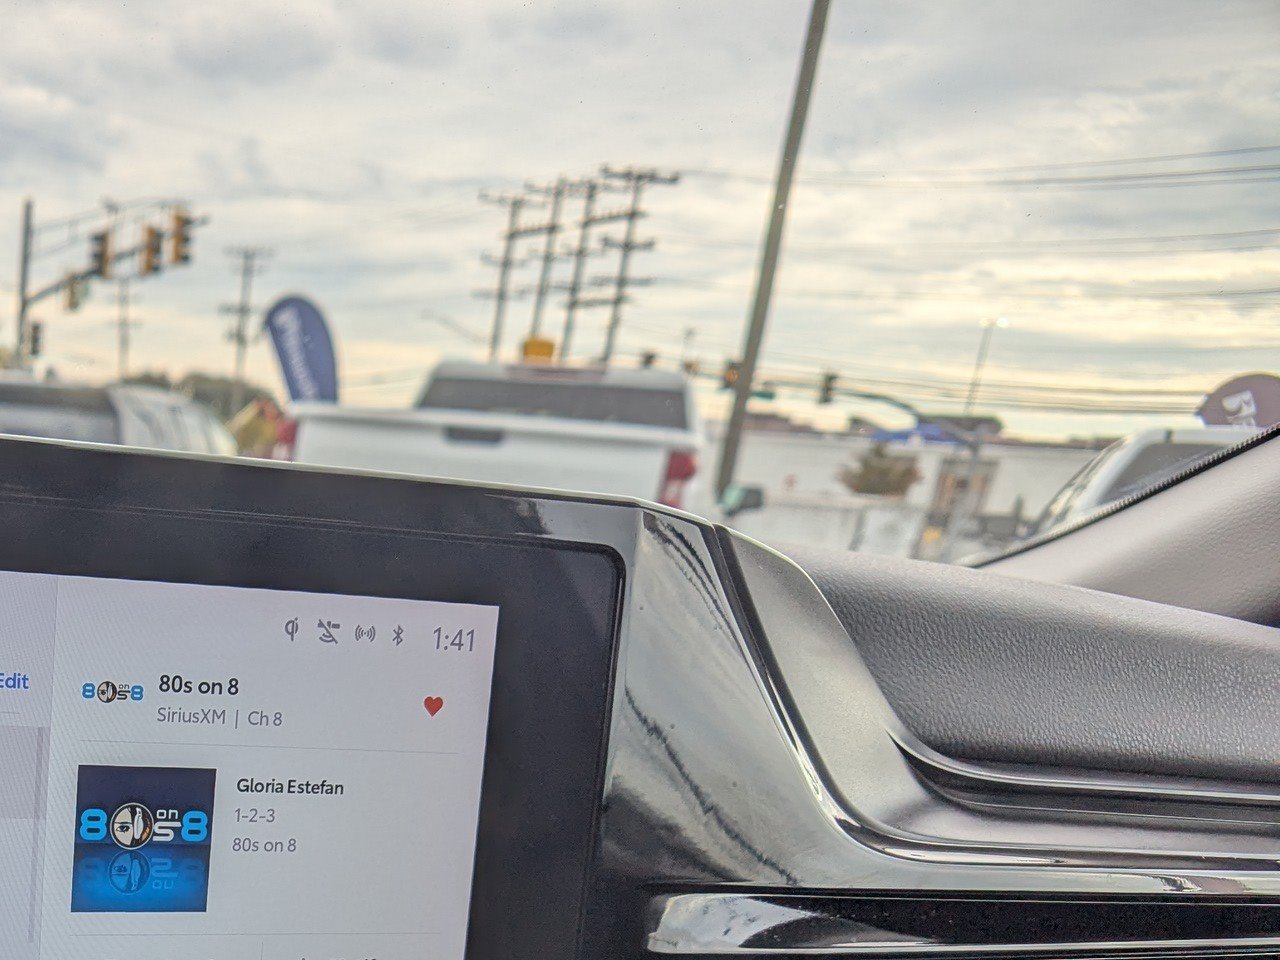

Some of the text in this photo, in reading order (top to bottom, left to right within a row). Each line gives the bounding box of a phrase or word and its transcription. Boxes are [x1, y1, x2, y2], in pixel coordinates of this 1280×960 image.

[433, 626, 475, 652] 1:41
[158, 674, 239, 696] 80s on 8
[157, 706, 226, 726] SiriusXM
[247, 710, 272, 727] Ch
[272, 711, 283, 727] 8
[236, 777, 344, 796] Gloria Estefan
[234, 808, 276, 824] 1-2-3
[232, 837, 297, 854] 80s on 8
